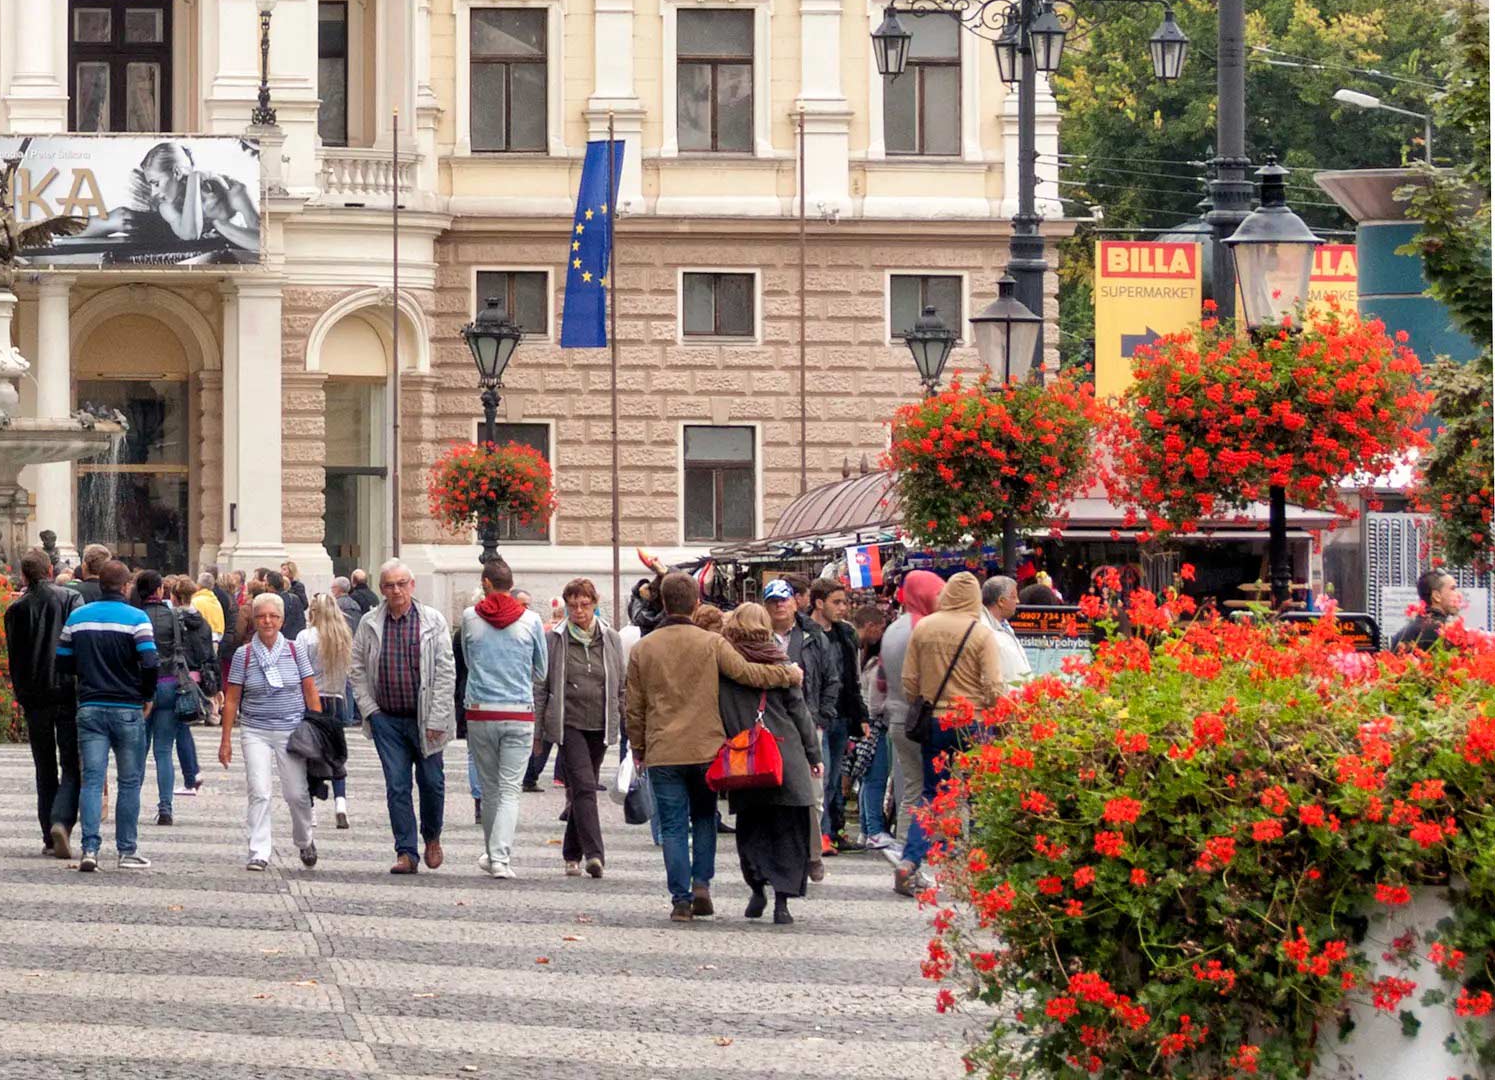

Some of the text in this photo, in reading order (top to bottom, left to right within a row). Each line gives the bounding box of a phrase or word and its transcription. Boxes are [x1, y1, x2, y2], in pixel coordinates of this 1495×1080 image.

[1107, 248, 1191, 273] BILLA
[1311, 251, 1357, 276] LLA
[1101, 286, 1195, 299] SUPERMARKET
